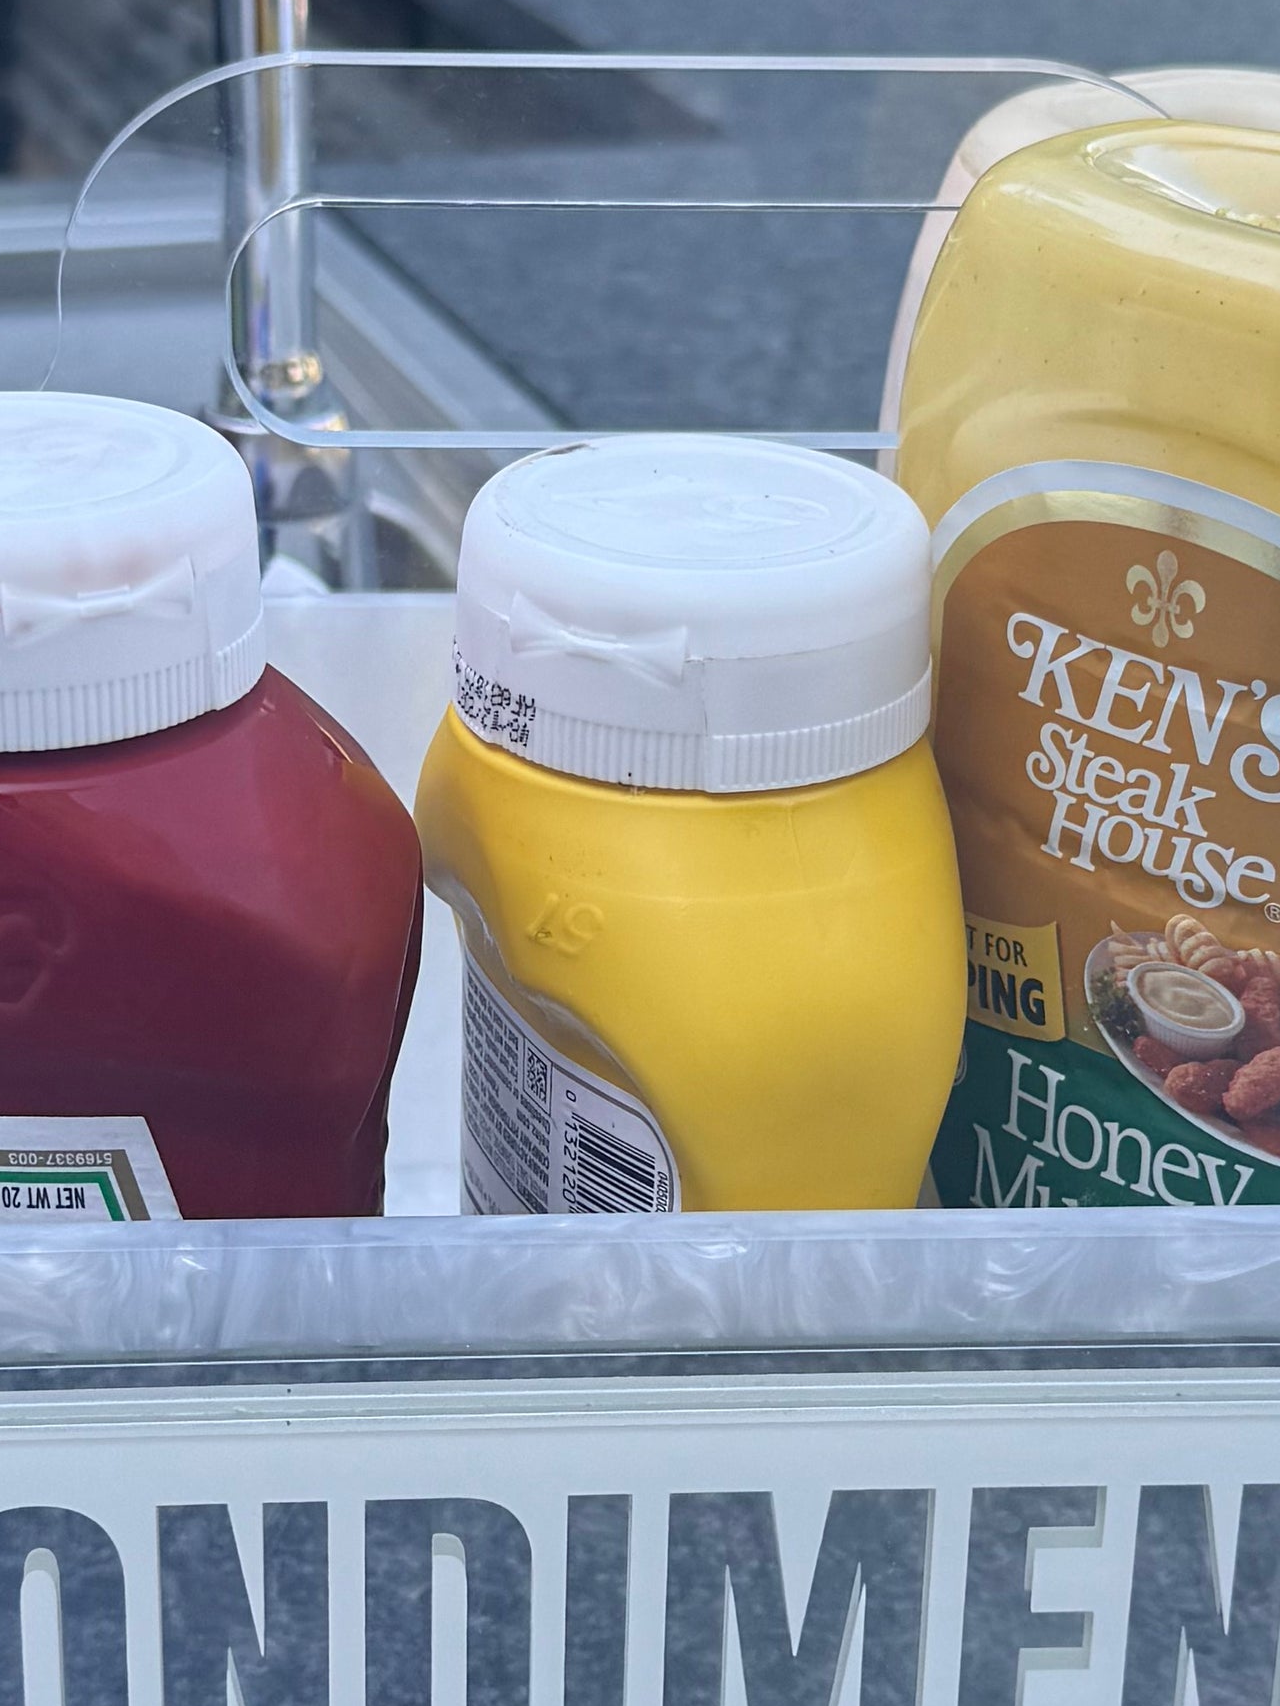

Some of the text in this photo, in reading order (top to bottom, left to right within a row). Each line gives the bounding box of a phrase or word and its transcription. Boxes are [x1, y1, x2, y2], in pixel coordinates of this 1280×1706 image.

[1026, 722, 1216, 837] Steak
[1041, 793, 1277, 909] House
[985, 932, 1028, 967] FOR
[565, 1089, 577, 1103] 0
[1001, 1048, 1254, 1206] Honey
[8, 1152, 112, 1166] 5169337-003
[2, 1186, 20, 1208] 20
[26, 1186, 51, 1209] WT
[55, 1187, 86, 1209] NET
